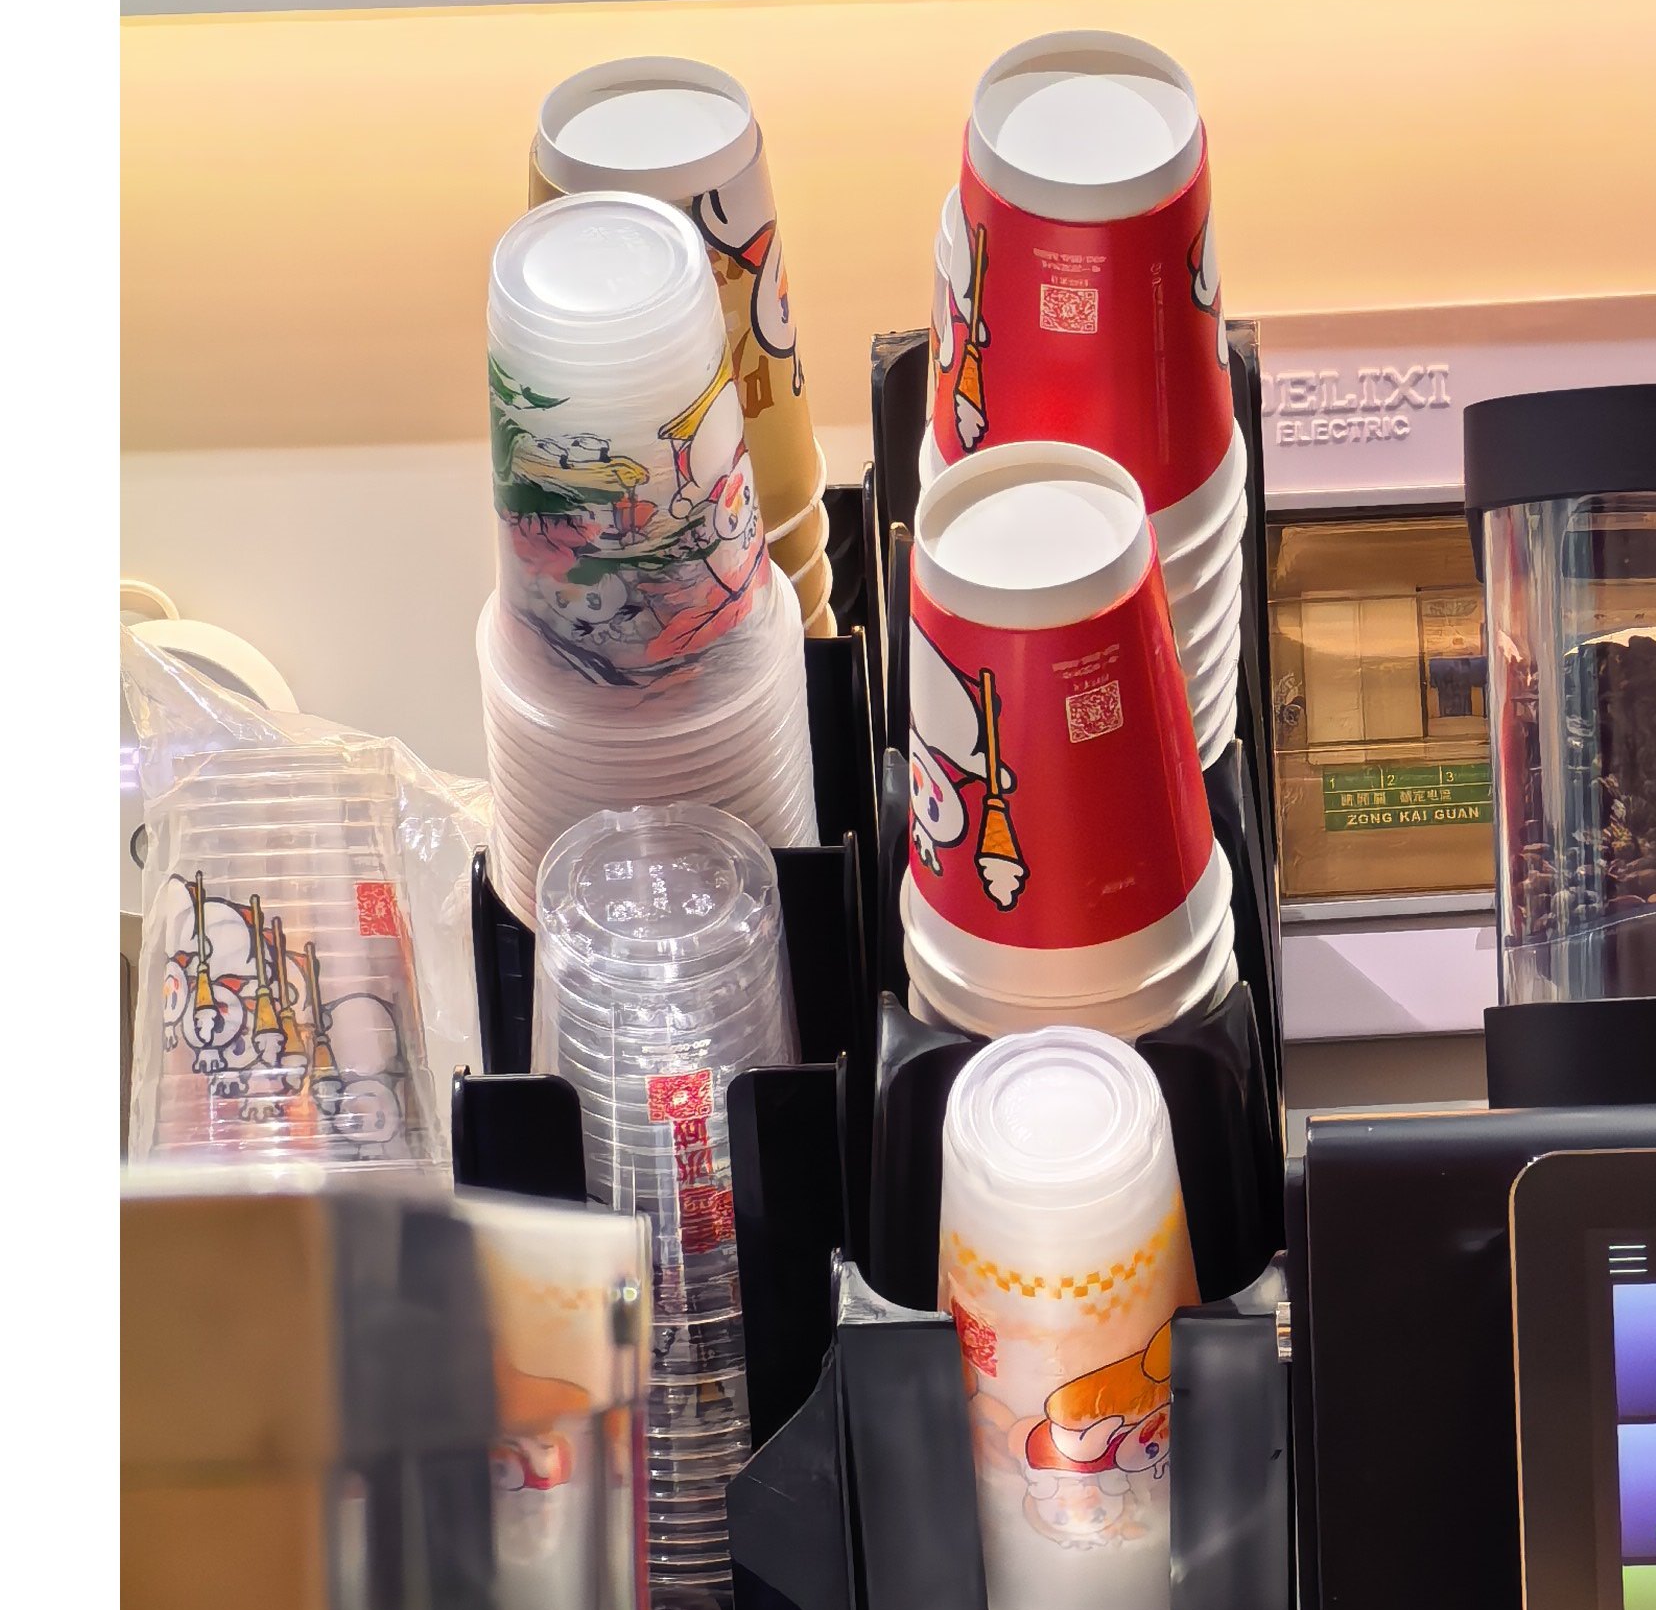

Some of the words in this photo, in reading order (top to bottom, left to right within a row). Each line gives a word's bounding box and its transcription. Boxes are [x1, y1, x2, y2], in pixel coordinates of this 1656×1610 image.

[1276, 415, 1411, 447] ELECTRIC
[1387, 774, 1396, 787] 2
[1446, 771, 1455, 783] 3
[1348, 812, 1393, 825] ZONG
[1399, 810, 1427, 823] KAI
[1434, 806, 1480, 820] GUAN
